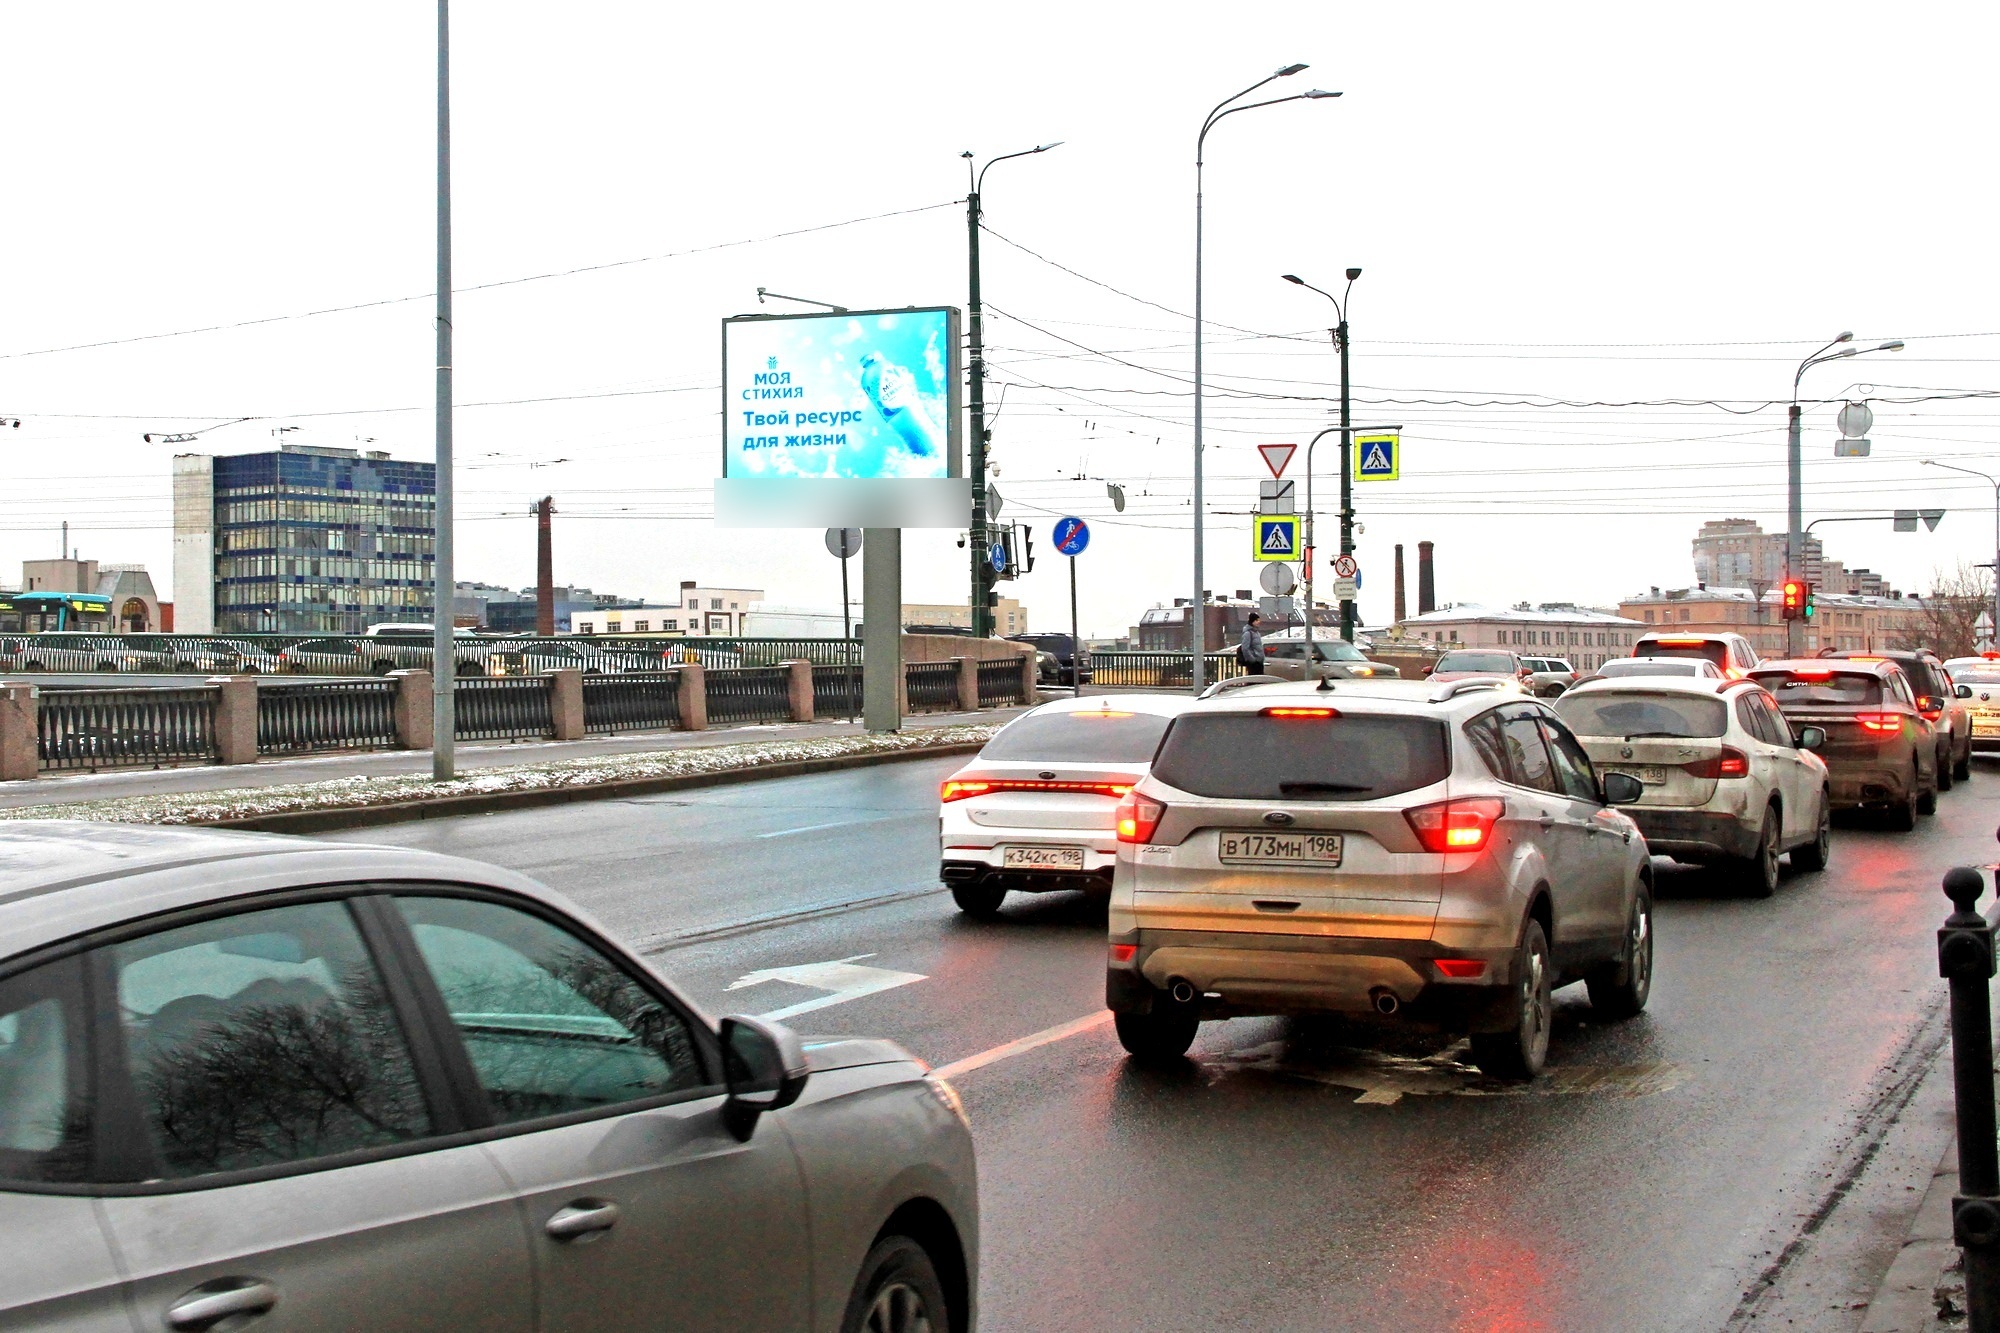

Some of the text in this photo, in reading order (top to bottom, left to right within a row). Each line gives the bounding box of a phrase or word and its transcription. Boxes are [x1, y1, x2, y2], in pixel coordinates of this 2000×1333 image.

[754, 372, 791, 385] МОЯ
[742, 387, 803, 400] СТИХИЯ
[743, 410, 862, 428] Твой ресурс
[743, 434, 847, 451] для жизни
[1307, 837, 1336, 853] 198
[1061, 851, 1081, 861] 198
